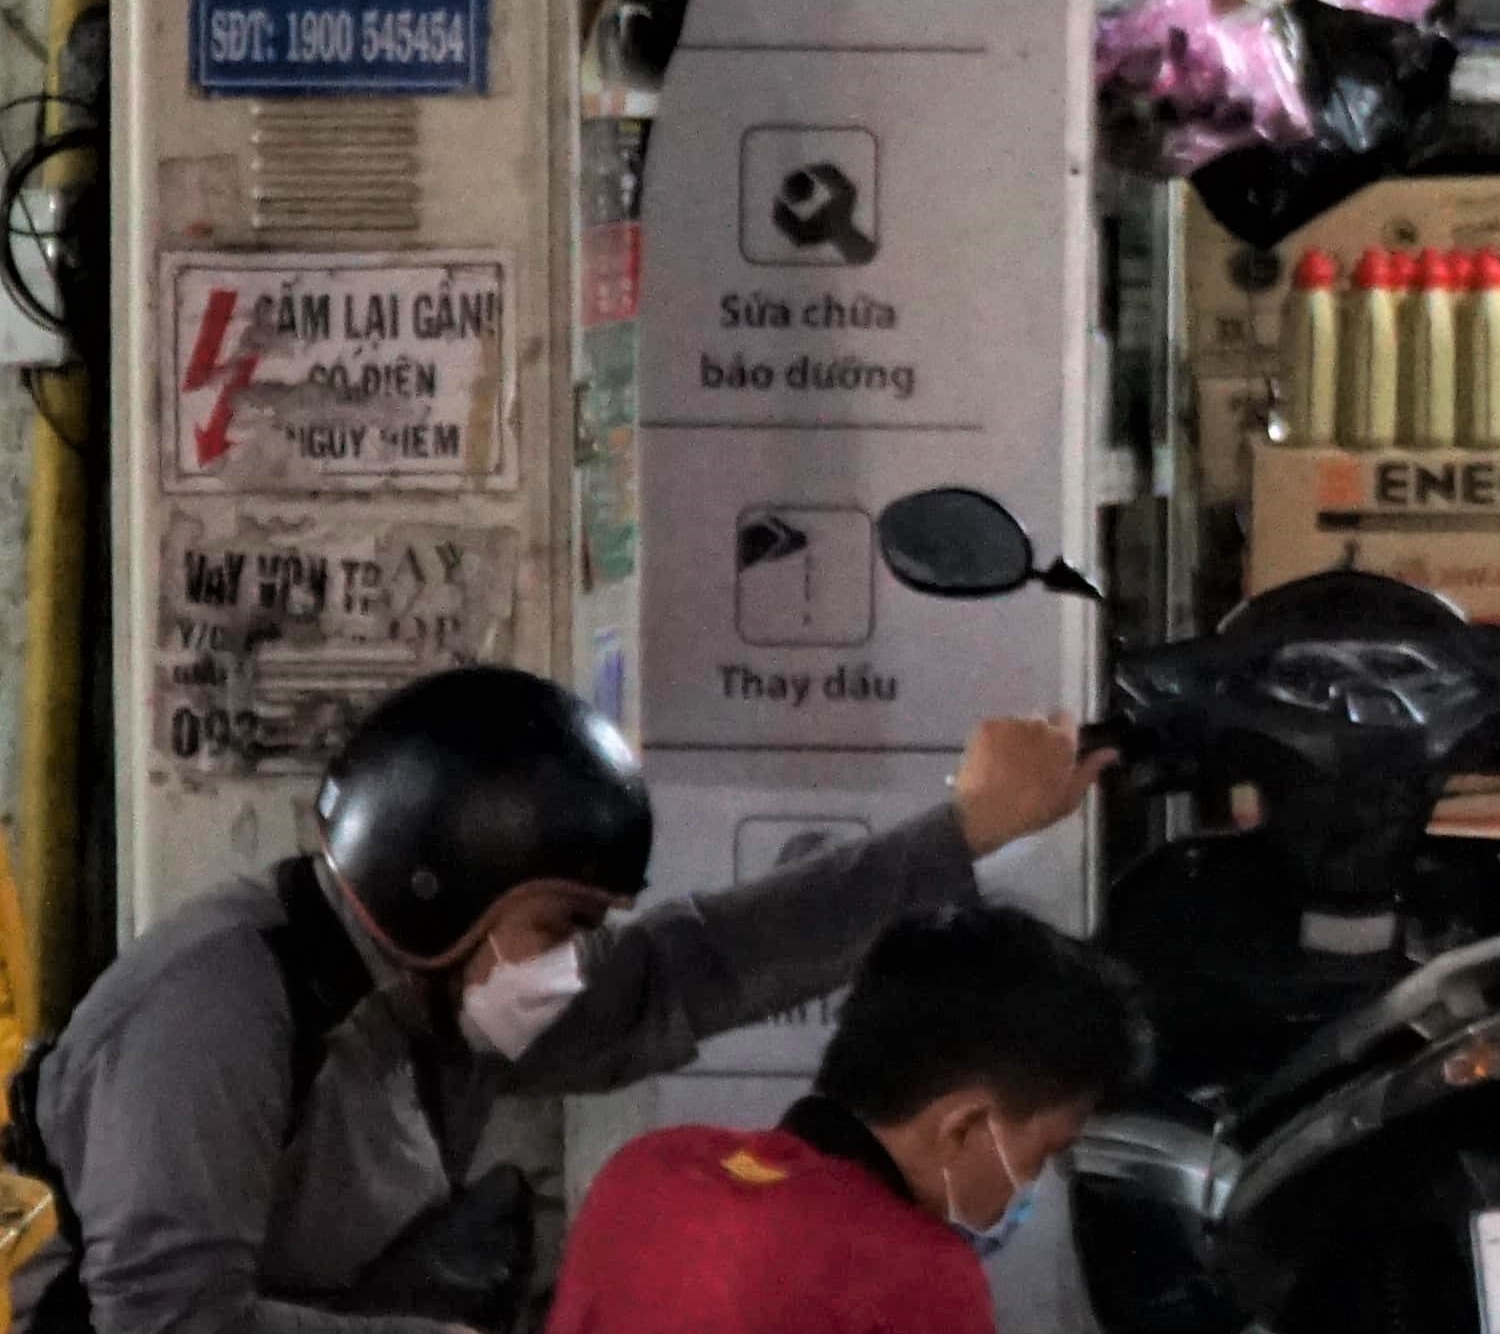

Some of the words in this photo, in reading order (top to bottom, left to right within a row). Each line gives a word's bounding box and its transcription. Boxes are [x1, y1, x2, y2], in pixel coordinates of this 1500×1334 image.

[287, 11, 353, 64] 1900
[361, 11, 465, 64] 545454
[717, 665, 811, 707] Thay
